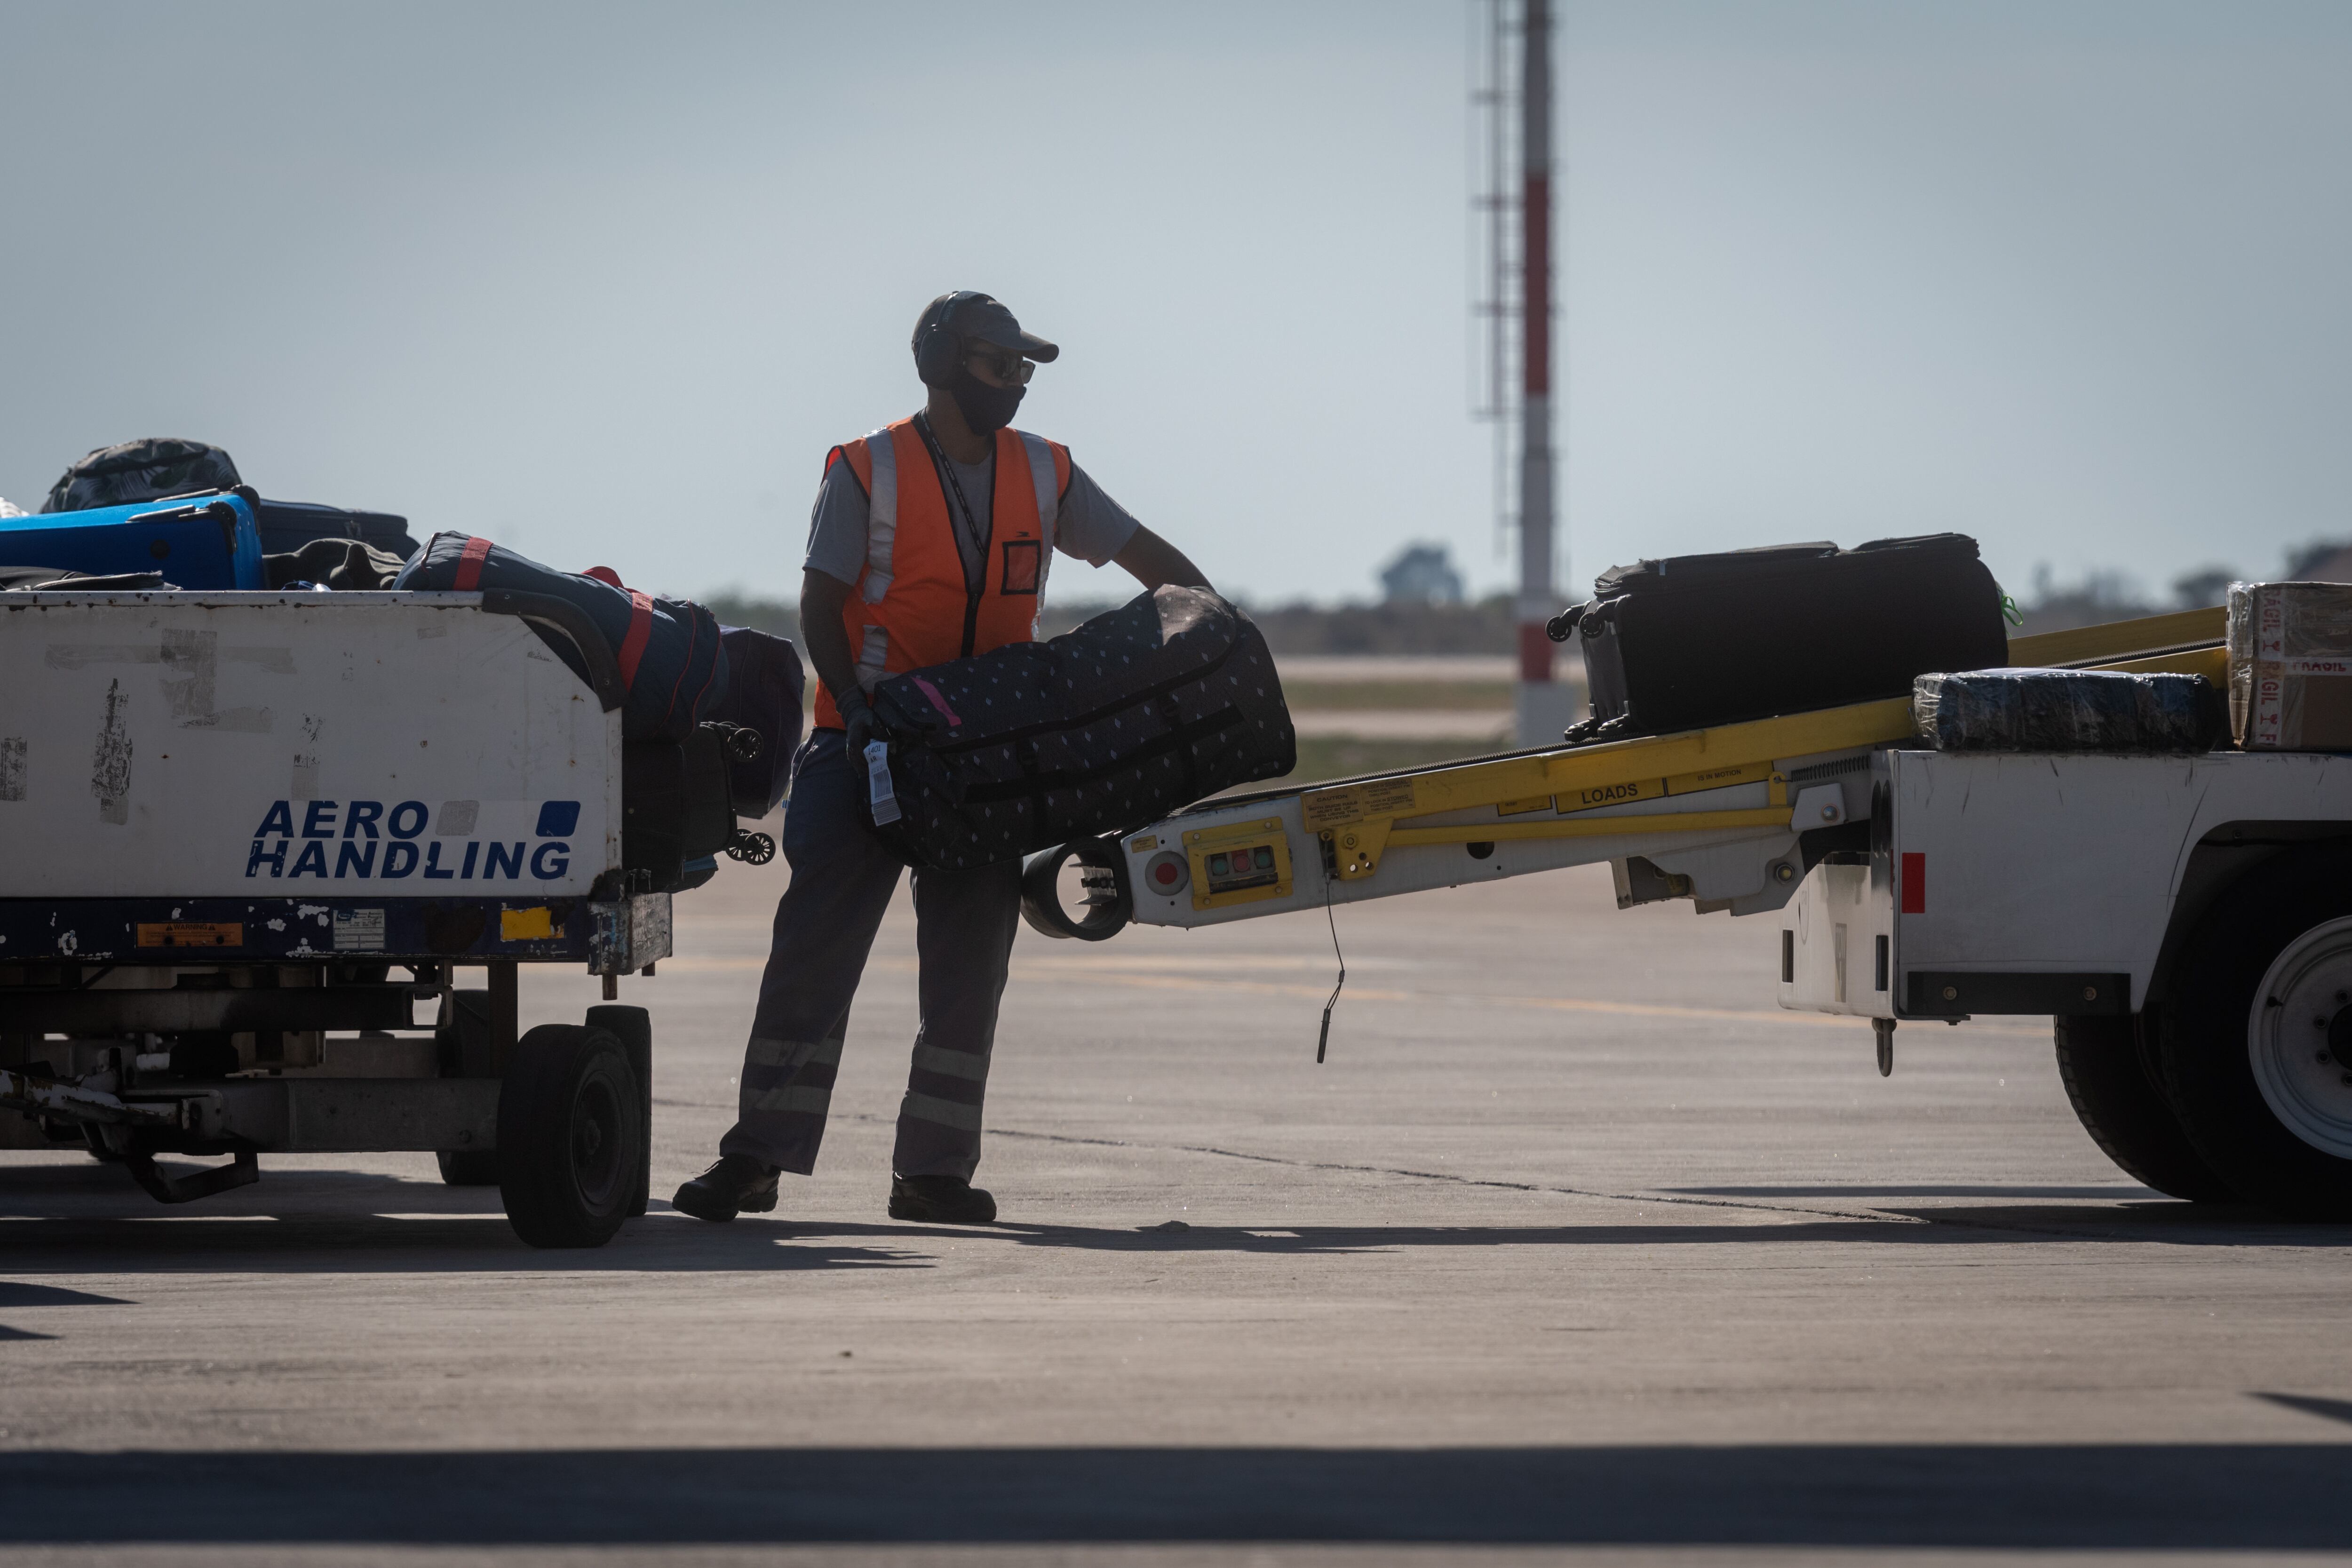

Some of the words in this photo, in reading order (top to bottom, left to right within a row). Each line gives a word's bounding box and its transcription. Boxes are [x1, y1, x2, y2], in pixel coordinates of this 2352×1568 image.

[2263, 589, 2281, 632] RAGIL
[2261, 661, 2280, 705] RAGIL
[868, 745, 881, 755] 1401
[1581, 783, 1638, 804] LOADS
[1715, 769, 1741, 779] MOTION
[254, 800, 429, 839] AERO
[245, 840, 571, 880] HANDLING
